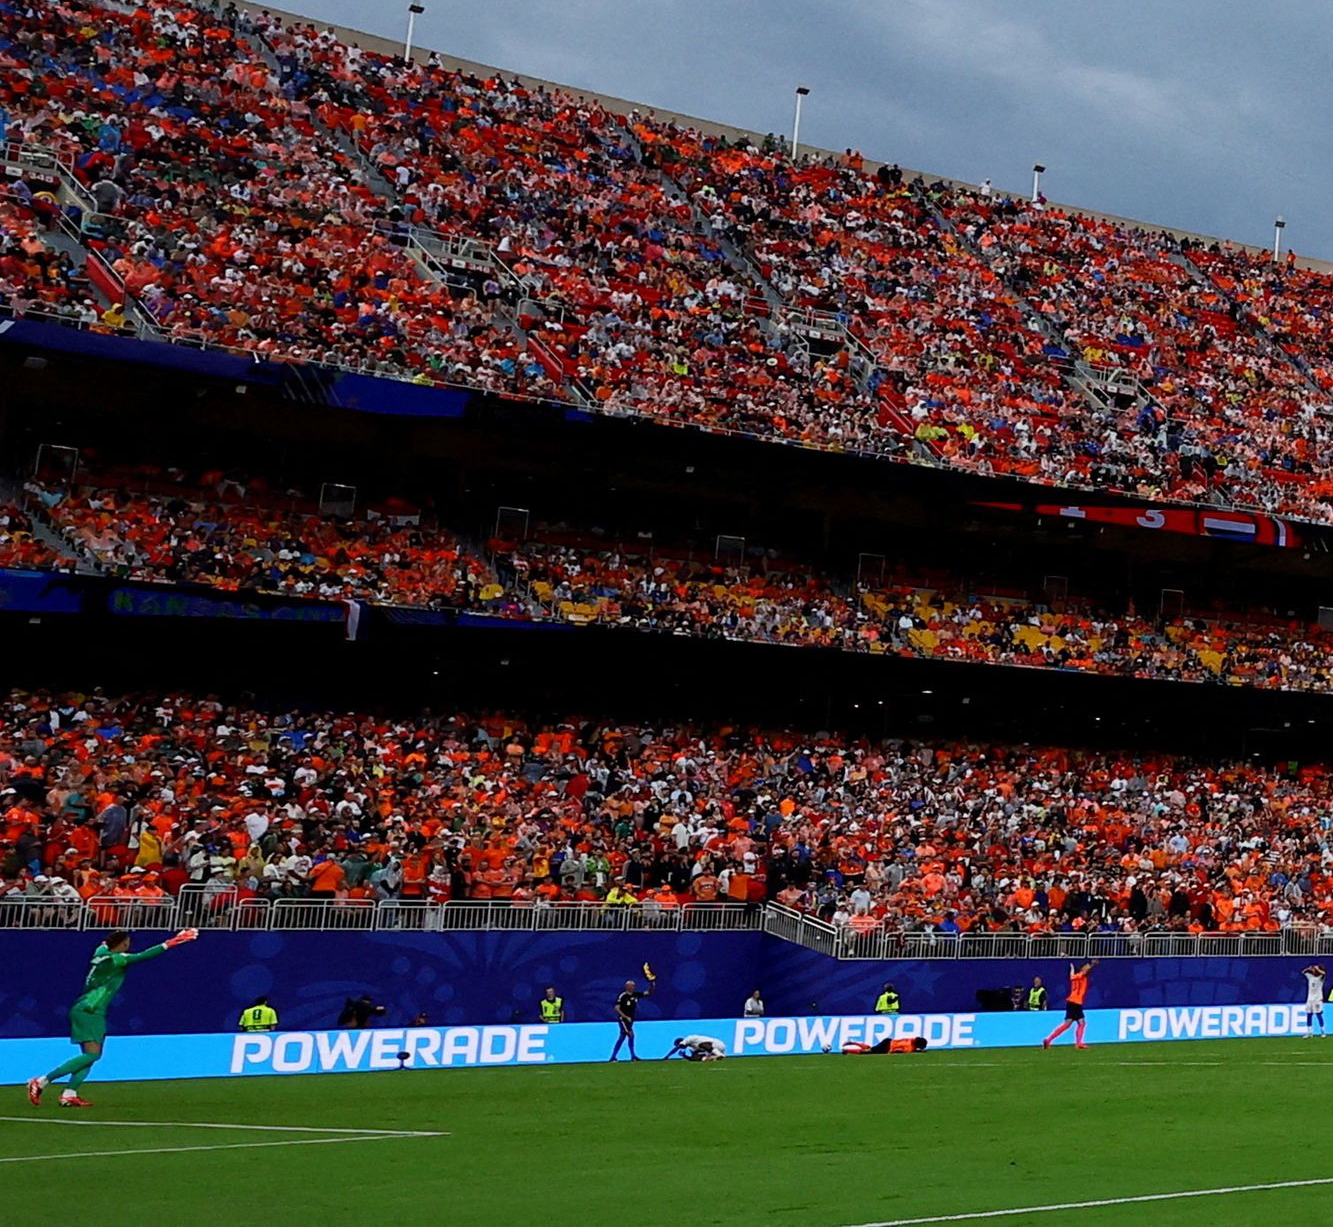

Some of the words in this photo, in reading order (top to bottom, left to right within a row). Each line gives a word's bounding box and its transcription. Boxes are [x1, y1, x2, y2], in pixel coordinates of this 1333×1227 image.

[733, 1014, 976, 1054] POWERADE
[1118, 1005, 1307, 1040] POWERADE
[231, 1025, 549, 1074] POWERADE
